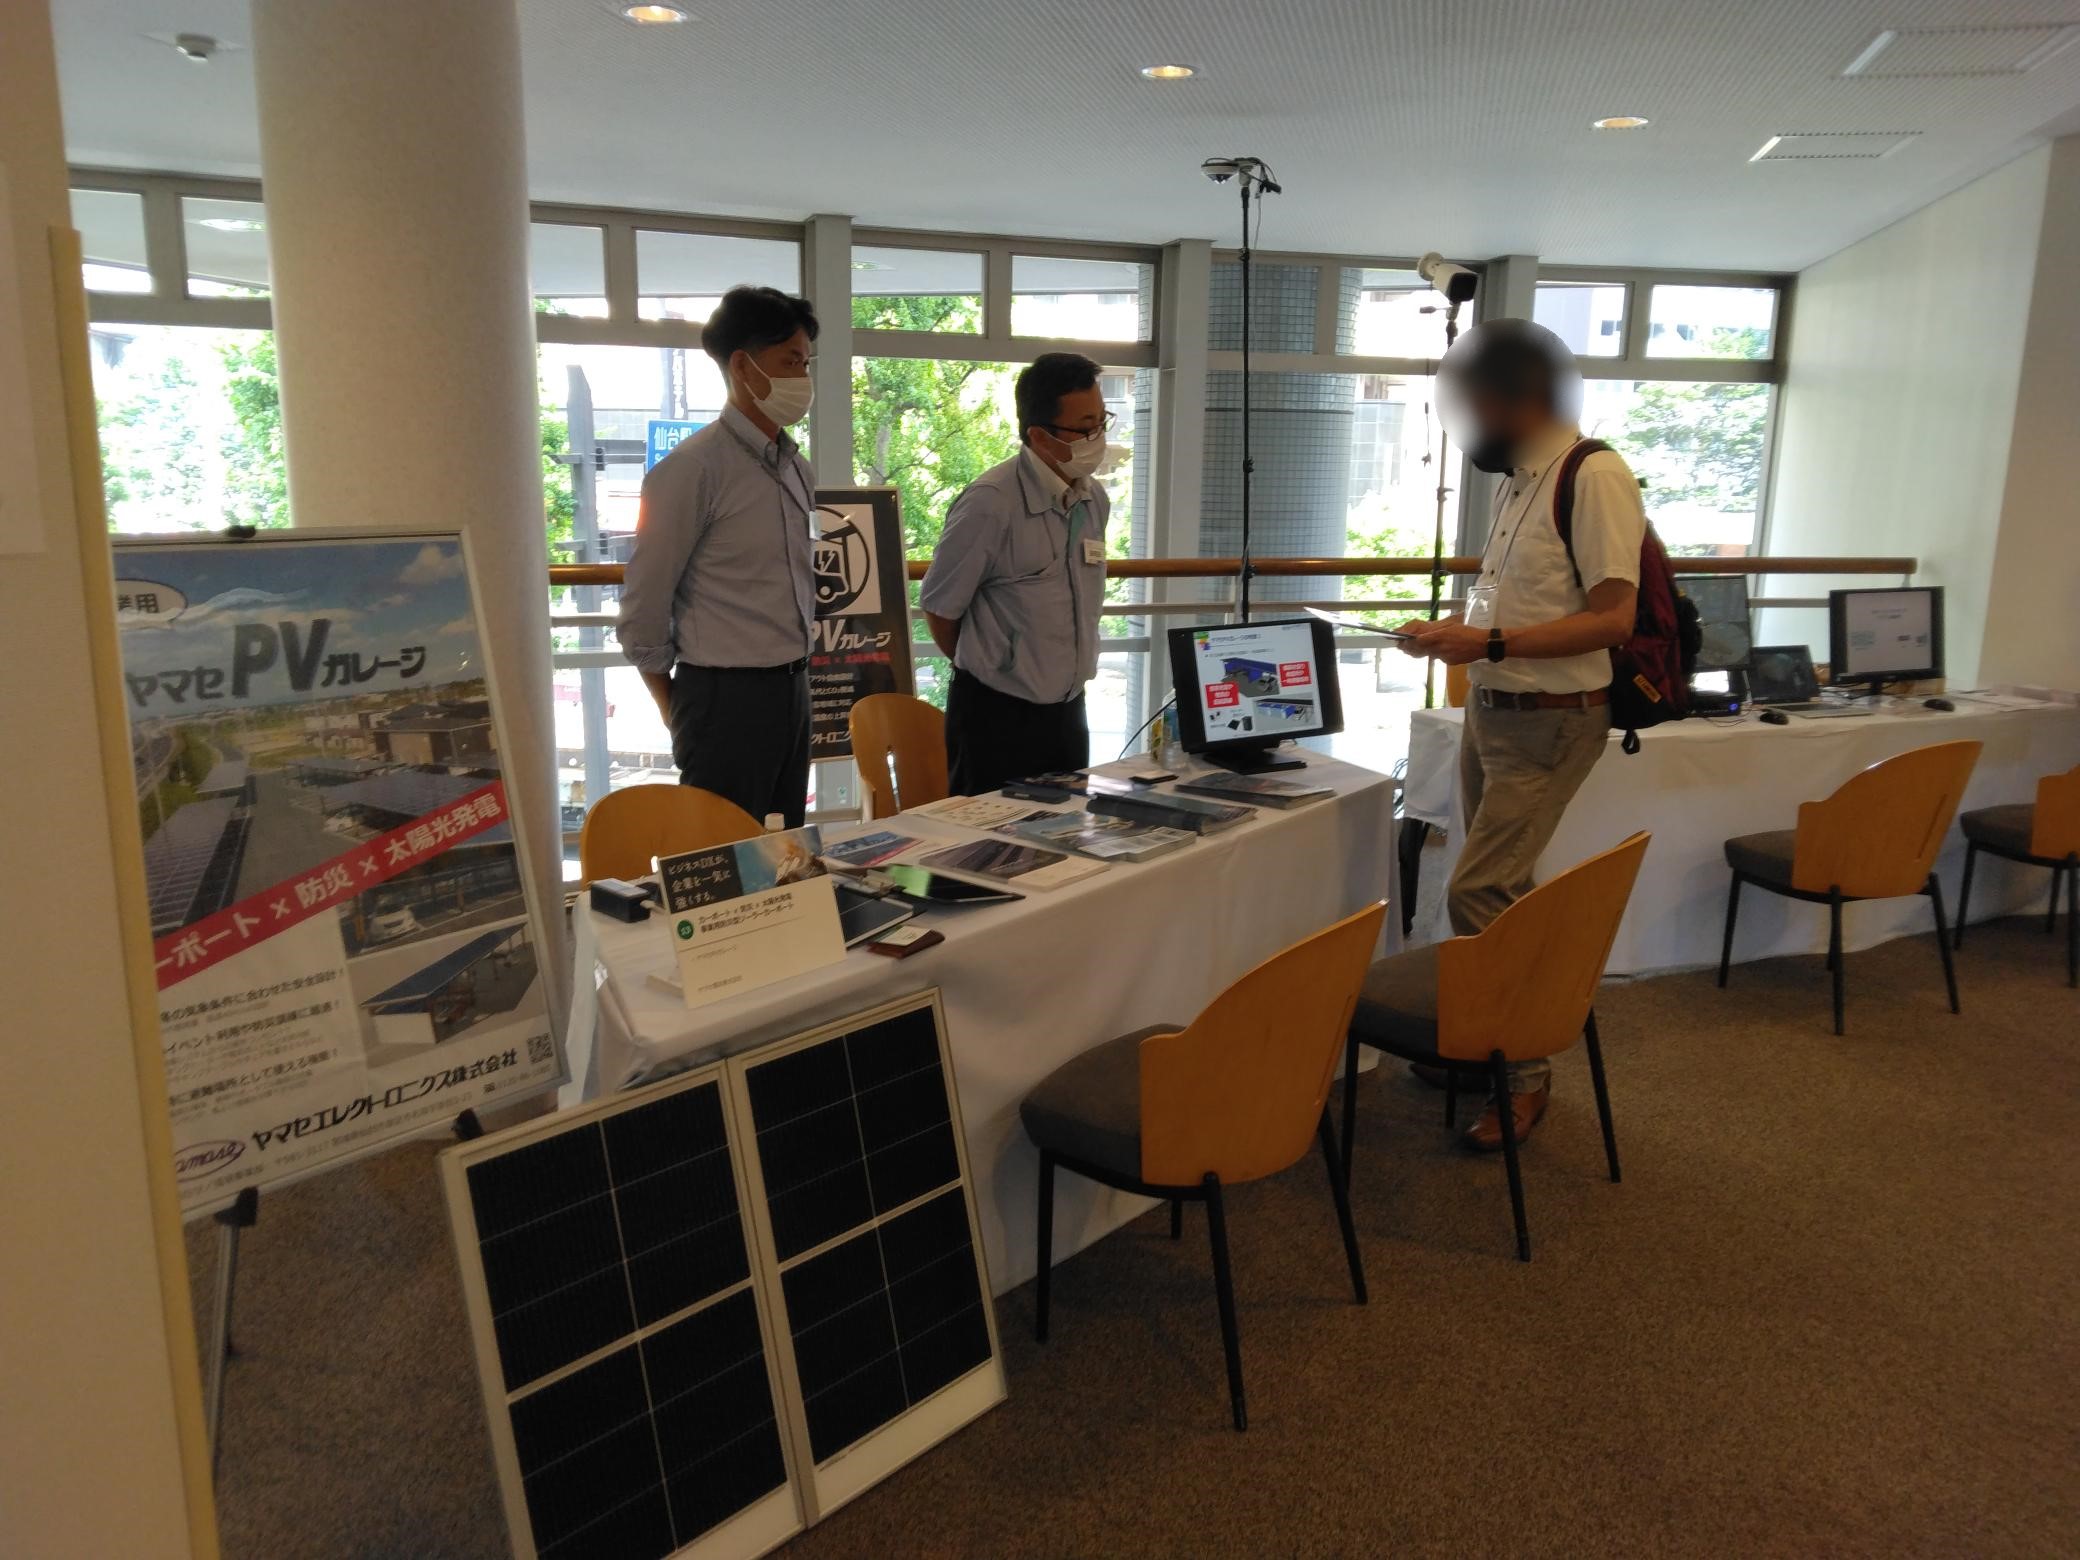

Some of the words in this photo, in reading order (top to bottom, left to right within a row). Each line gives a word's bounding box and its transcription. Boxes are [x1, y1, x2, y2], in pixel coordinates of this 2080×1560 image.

[295, 863, 355, 910] 防災
[383, 793, 503, 866] 太陽光発電
[252, 1047, 518, 1151] ヤマセエレクトロニクス株式会社
